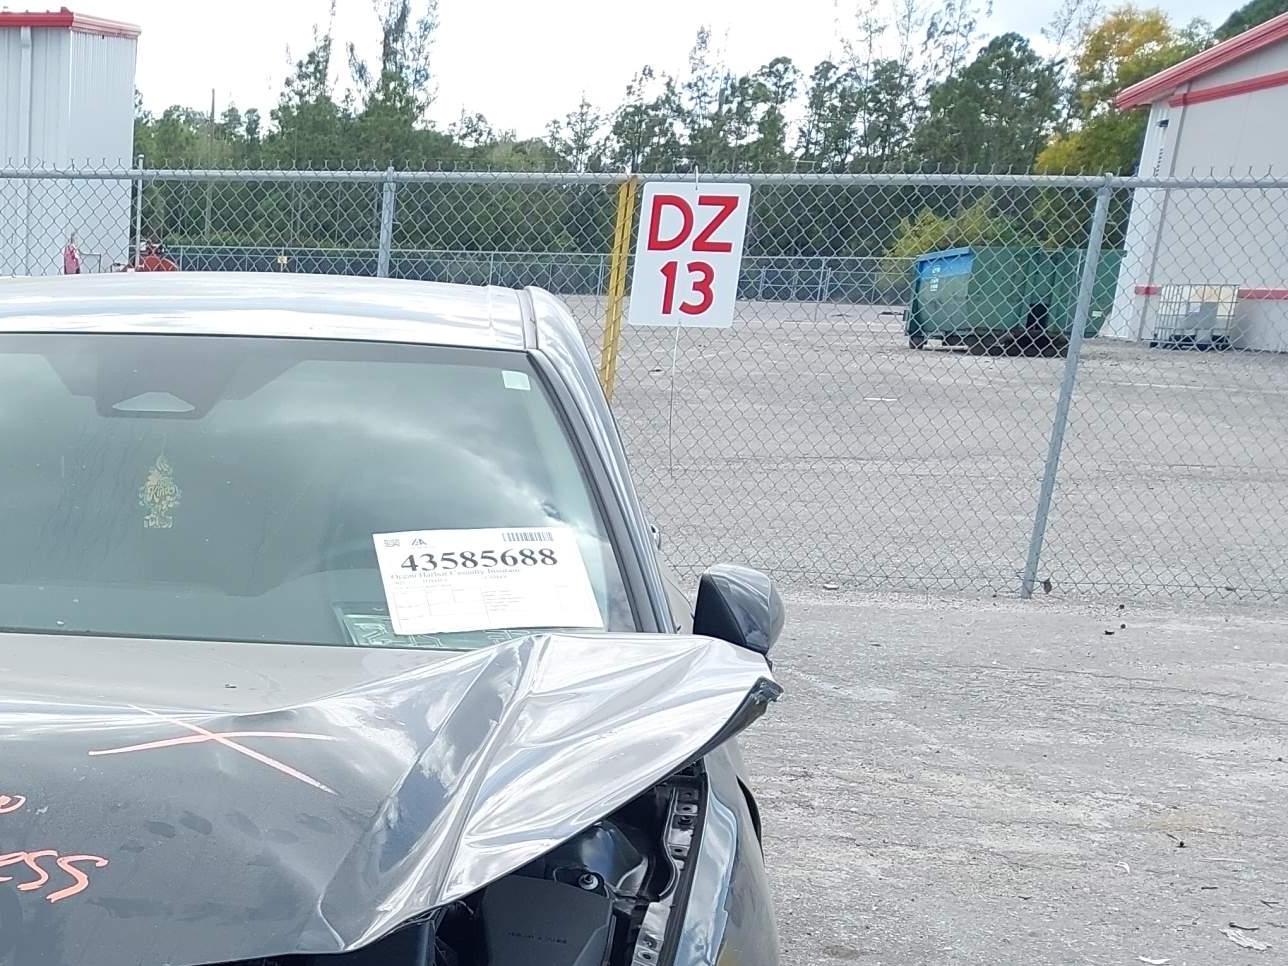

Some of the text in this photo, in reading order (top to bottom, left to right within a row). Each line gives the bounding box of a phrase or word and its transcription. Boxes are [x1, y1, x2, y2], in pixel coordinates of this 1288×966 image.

[647, 195, 739, 252] DZ
[660, 261, 715, 315] 13
[400, 548, 558, 572] 43585688
